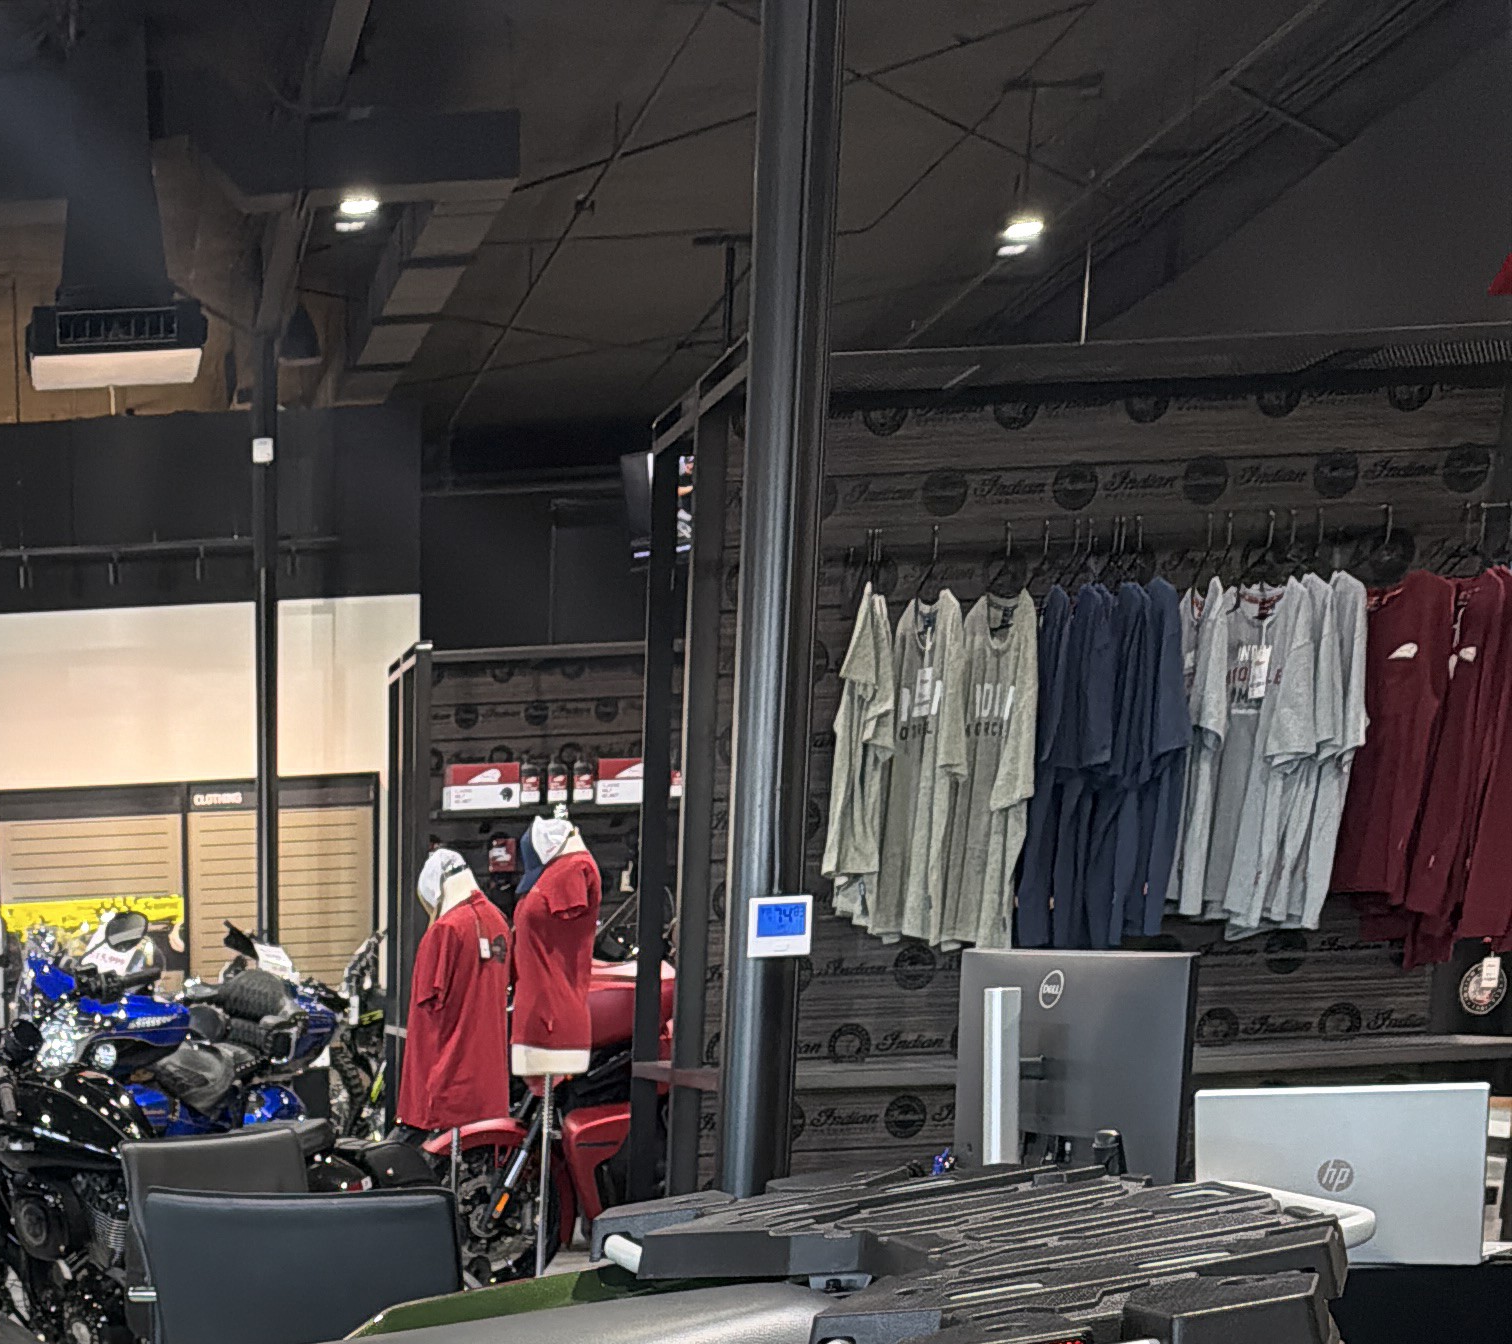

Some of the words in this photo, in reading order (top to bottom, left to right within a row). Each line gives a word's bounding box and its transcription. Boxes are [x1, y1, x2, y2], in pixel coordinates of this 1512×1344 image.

[193, 792, 243, 807] CLOTHING
[774, 905, 793, 923] 74
[1042, 984, 1060, 995] DELL
[876, 1030, 945, 1052] Indian
[810, 1107, 879, 1128] Indian
[1321, 1160, 1351, 1191] hp
